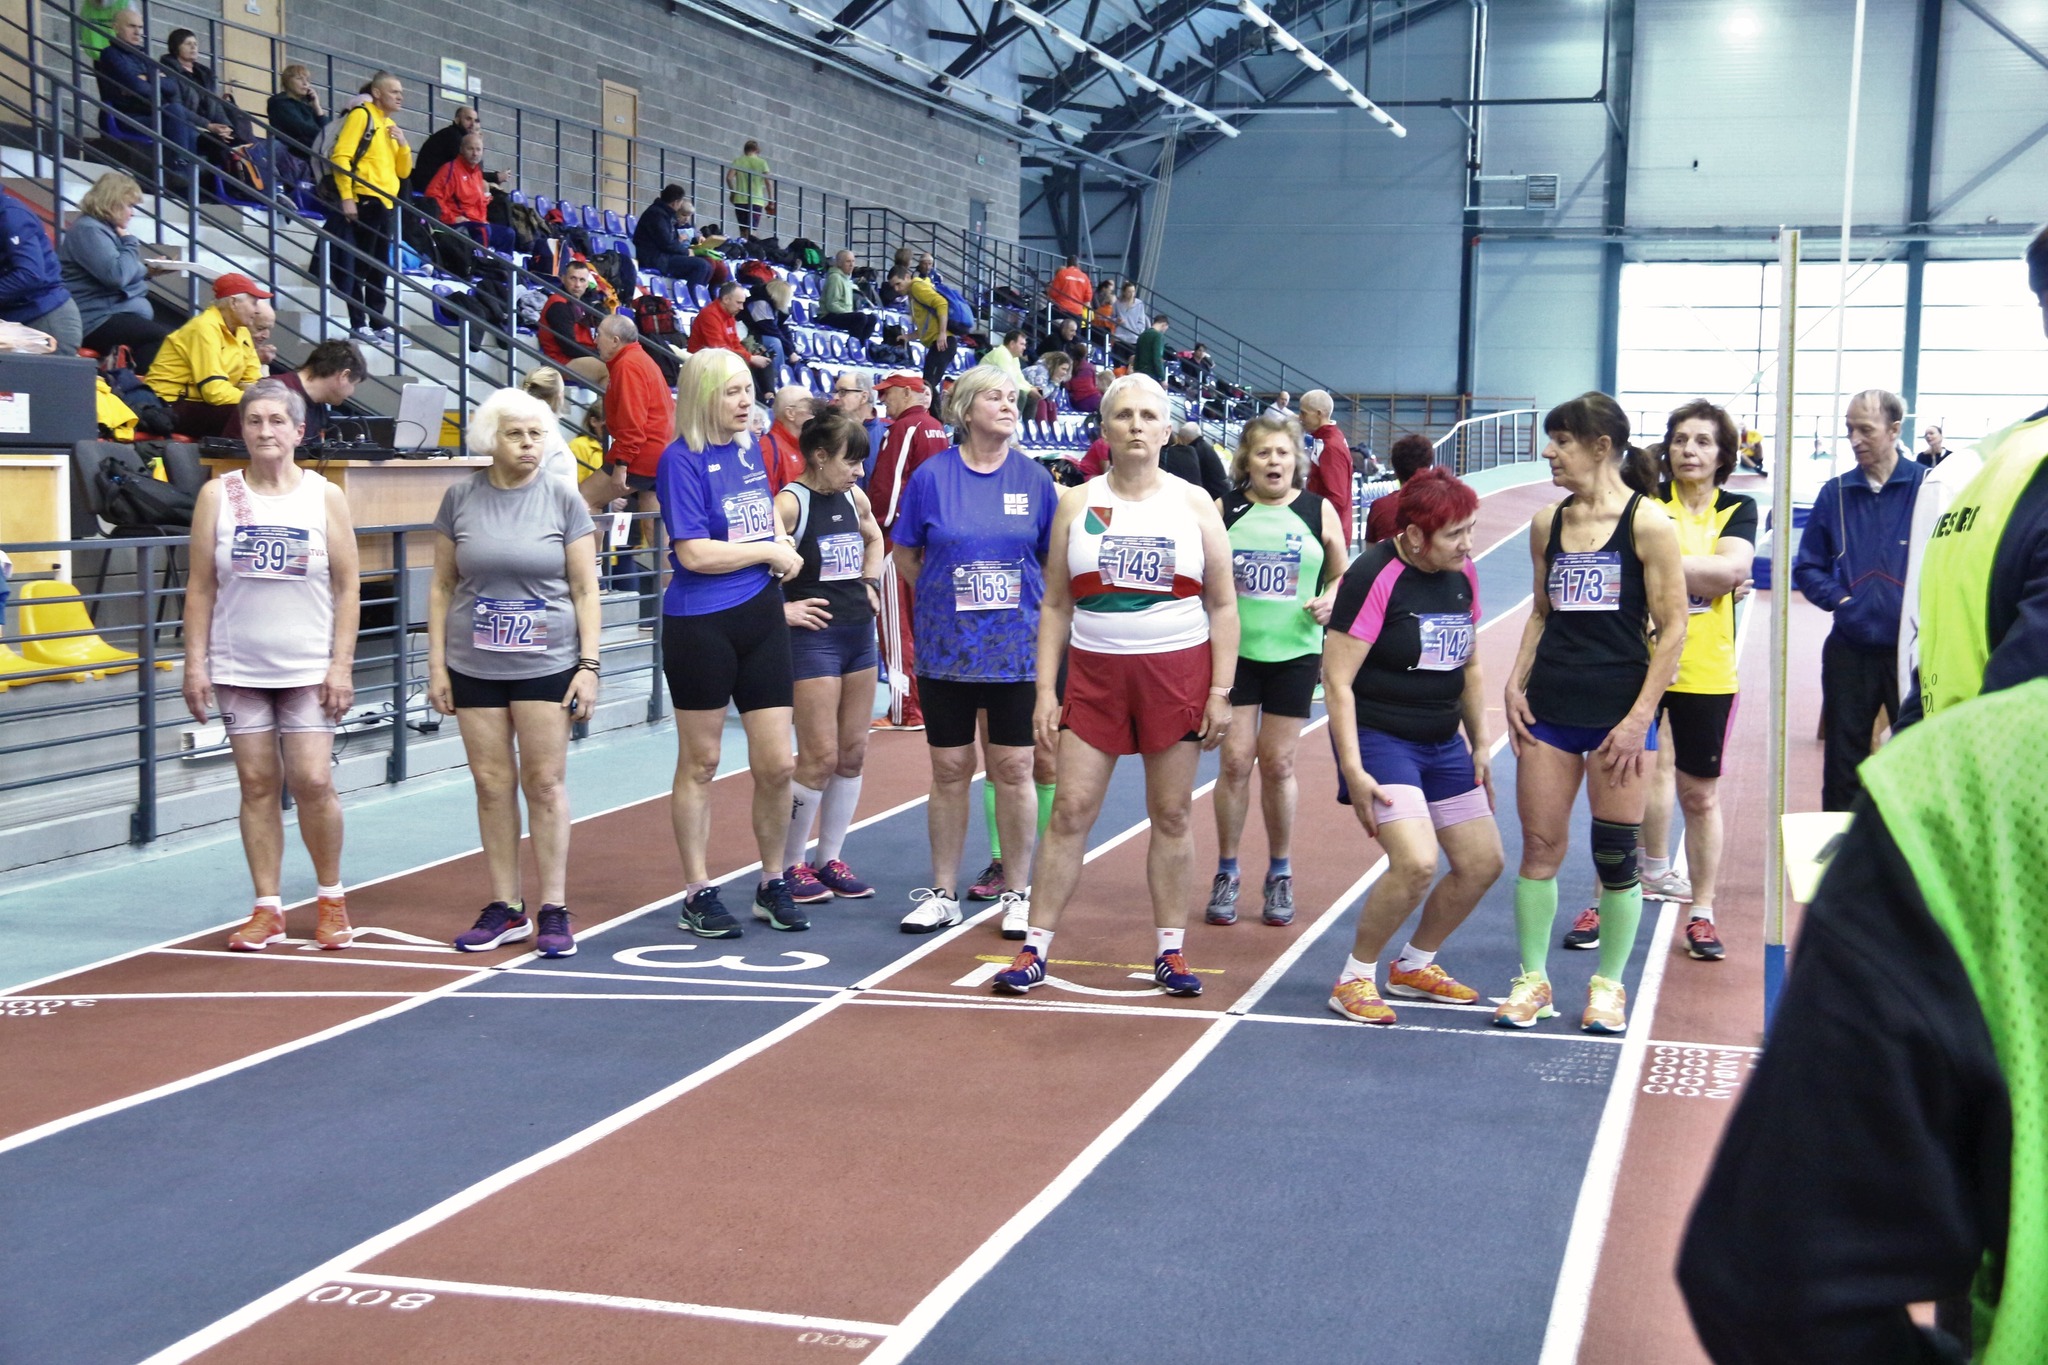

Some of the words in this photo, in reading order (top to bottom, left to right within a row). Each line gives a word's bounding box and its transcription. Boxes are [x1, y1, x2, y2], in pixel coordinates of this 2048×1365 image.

[738, 502, 769, 535] 163
[252, 538, 288, 572] 39
[833, 545, 860, 574] 146
[1116, 547, 1162, 583] 143
[968, 572, 1009, 603] 153
[1244, 562, 1288, 594] 308
[1560, 567, 1605, 604] 173
[489, 613, 533, 645] 172
[1437, 627, 1470, 663] 142
[308, 1286, 436, 1309] 800
